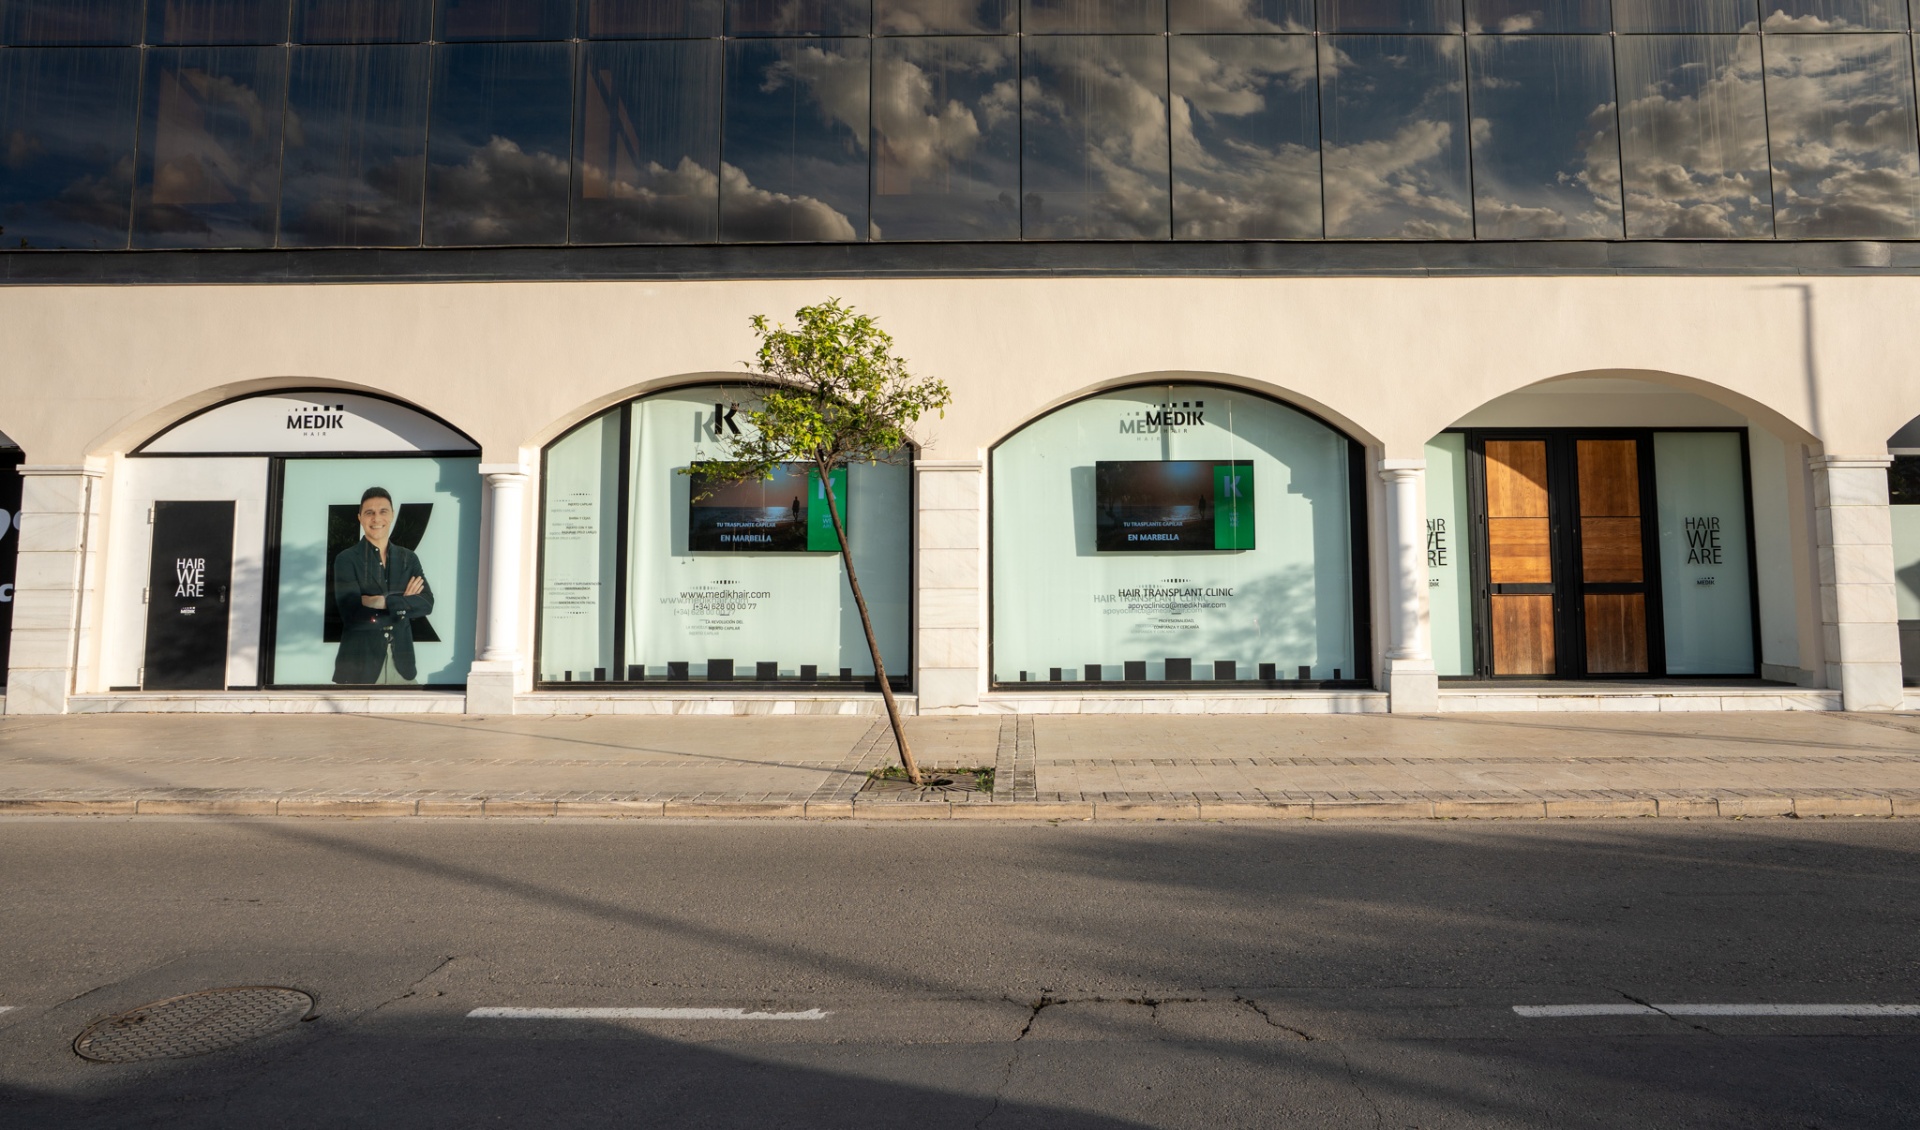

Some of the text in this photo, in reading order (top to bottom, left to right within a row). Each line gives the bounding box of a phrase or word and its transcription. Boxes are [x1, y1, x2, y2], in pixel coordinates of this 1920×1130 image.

[287, 414, 344, 429] MEDIK
[1145, 411, 1204, 426] MEDIK
[1223, 475, 1243, 498] K
[1426, 518, 1446, 531] AIR
[1685, 517, 1720, 530] HAIR
[720, 534, 772, 542] EN MARBELLA
[1686, 530, 1722, 548] WE
[176, 558, 205, 569] HAIR
[1428, 550, 1447, 566] RE
[1687, 549, 1722, 565] ARE
[177, 569, 205, 585] WE
[175, 584, 204, 597] ARE
[680, 590, 771, 599] www.medikhair.com
[1118, 588, 1234, 597] HAIR TRANSPLANT CLINIC
[1128, 602, 1227, 610] apoyoclinico@medikhair.com
